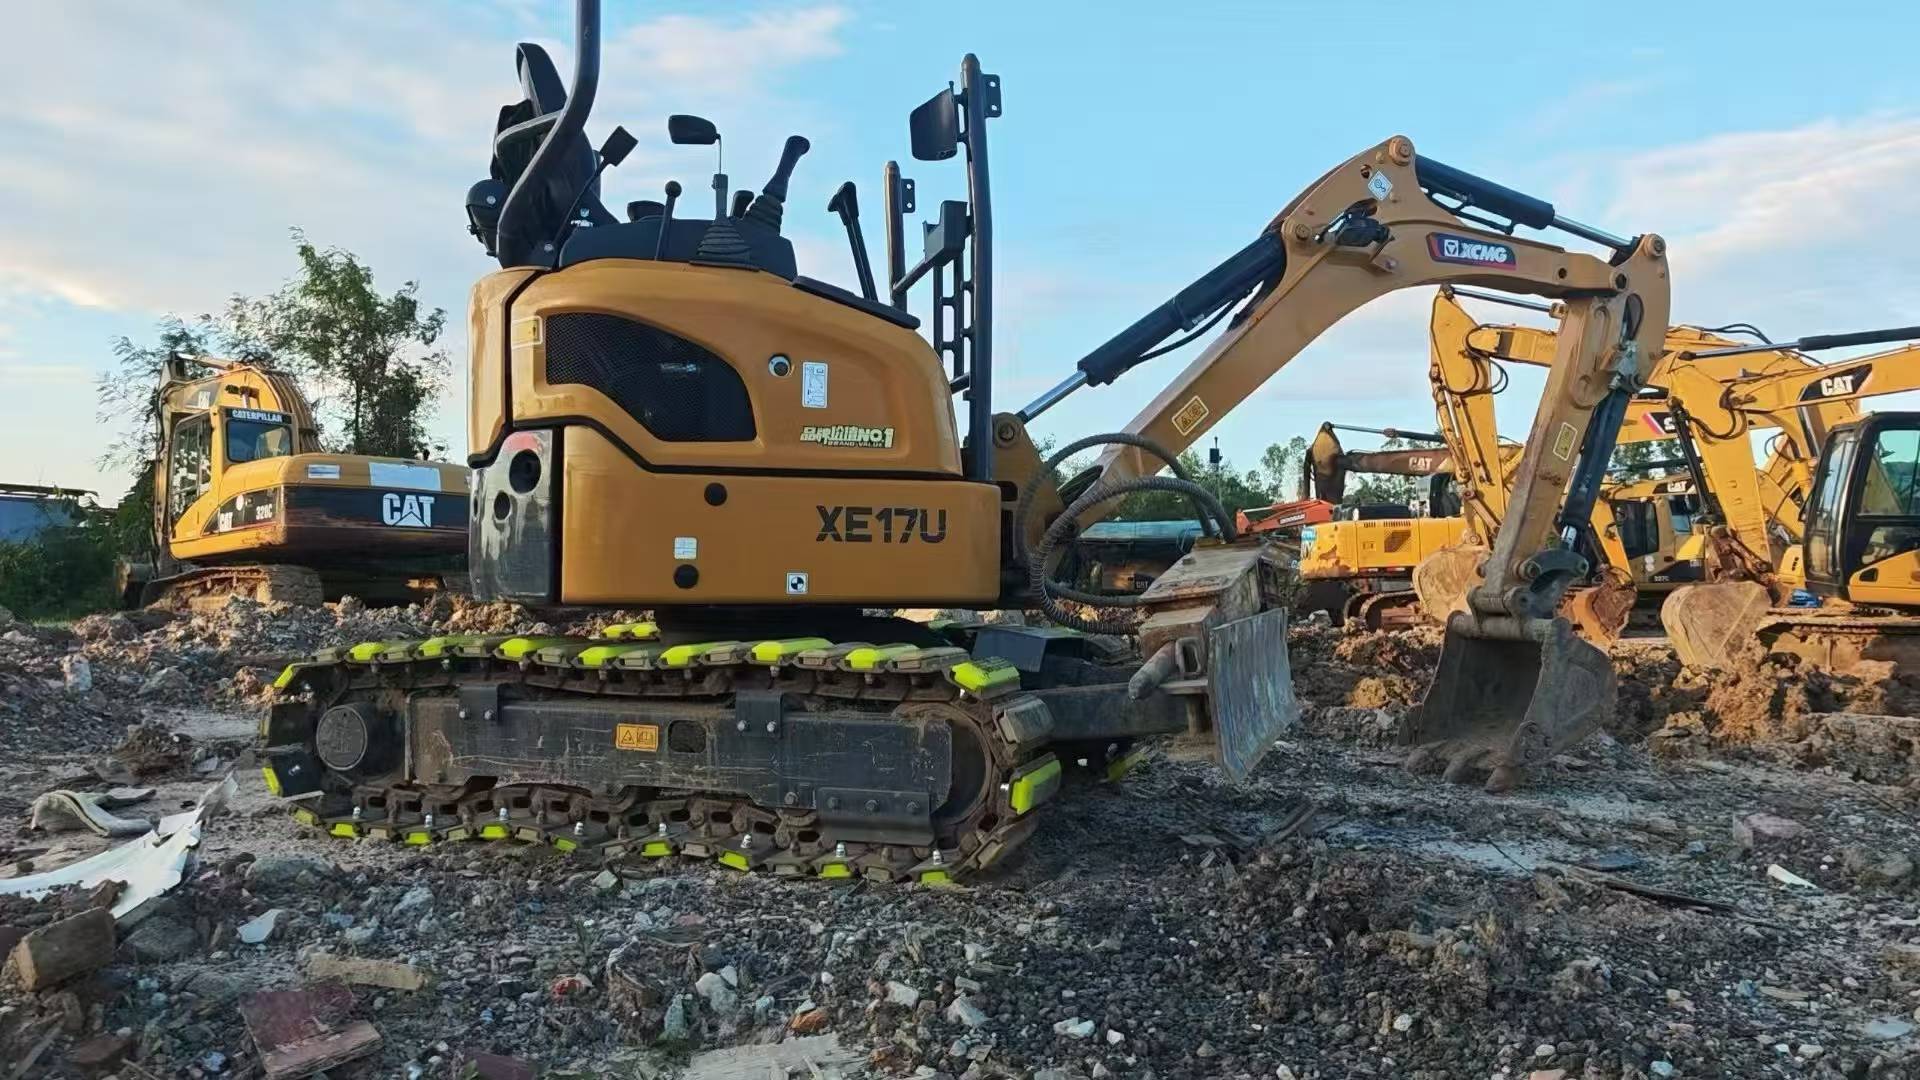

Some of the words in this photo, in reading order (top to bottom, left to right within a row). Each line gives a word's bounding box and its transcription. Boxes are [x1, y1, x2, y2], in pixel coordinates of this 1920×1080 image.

[1460, 243, 1507, 262] XCMG
[1821, 375, 1853, 396] CAT
[232, 409, 283, 422] CATERPILLAR
[1408, 456, 1432, 471] CAT
[1667, 480, 1687, 492] CAT
[383, 493, 435, 528] CAT
[816, 505, 947, 543] XE17U
